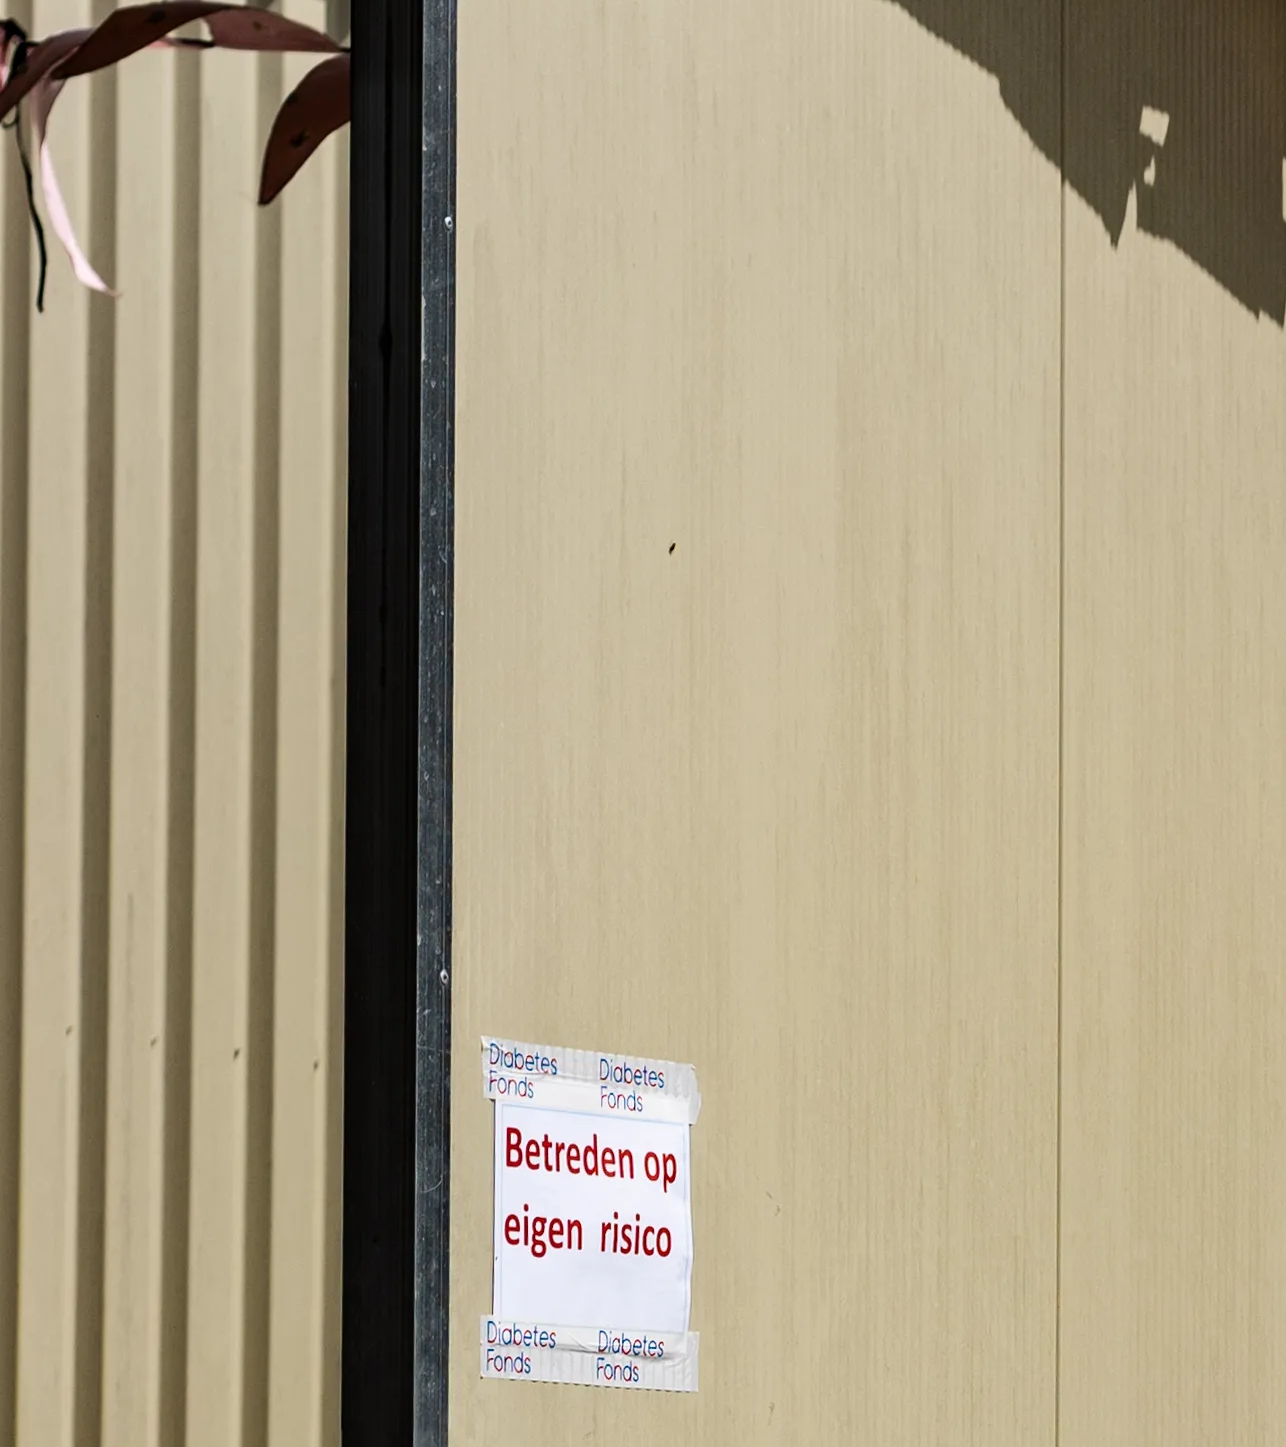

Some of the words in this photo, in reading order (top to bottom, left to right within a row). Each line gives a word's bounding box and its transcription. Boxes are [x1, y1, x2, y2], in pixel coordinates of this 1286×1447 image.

[489, 1043, 557, 1075] Diabetes
[599, 1058, 665, 1089] Diabetes
[488, 1070, 534, 1100] Fonds
[600, 1086, 643, 1113] Fonds
[505, 1127, 634, 1179] Betreden
[644, 1150, 678, 1193] op
[504, 1204, 583, 1259] eigen
[601, 1212, 673, 1258] risico
[486, 1320, 557, 1349] Diabetes
[598, 1330, 665, 1358] Diabetes
[486, 1349, 532, 1375] Fonds
[596, 1357, 640, 1383] Fonds
